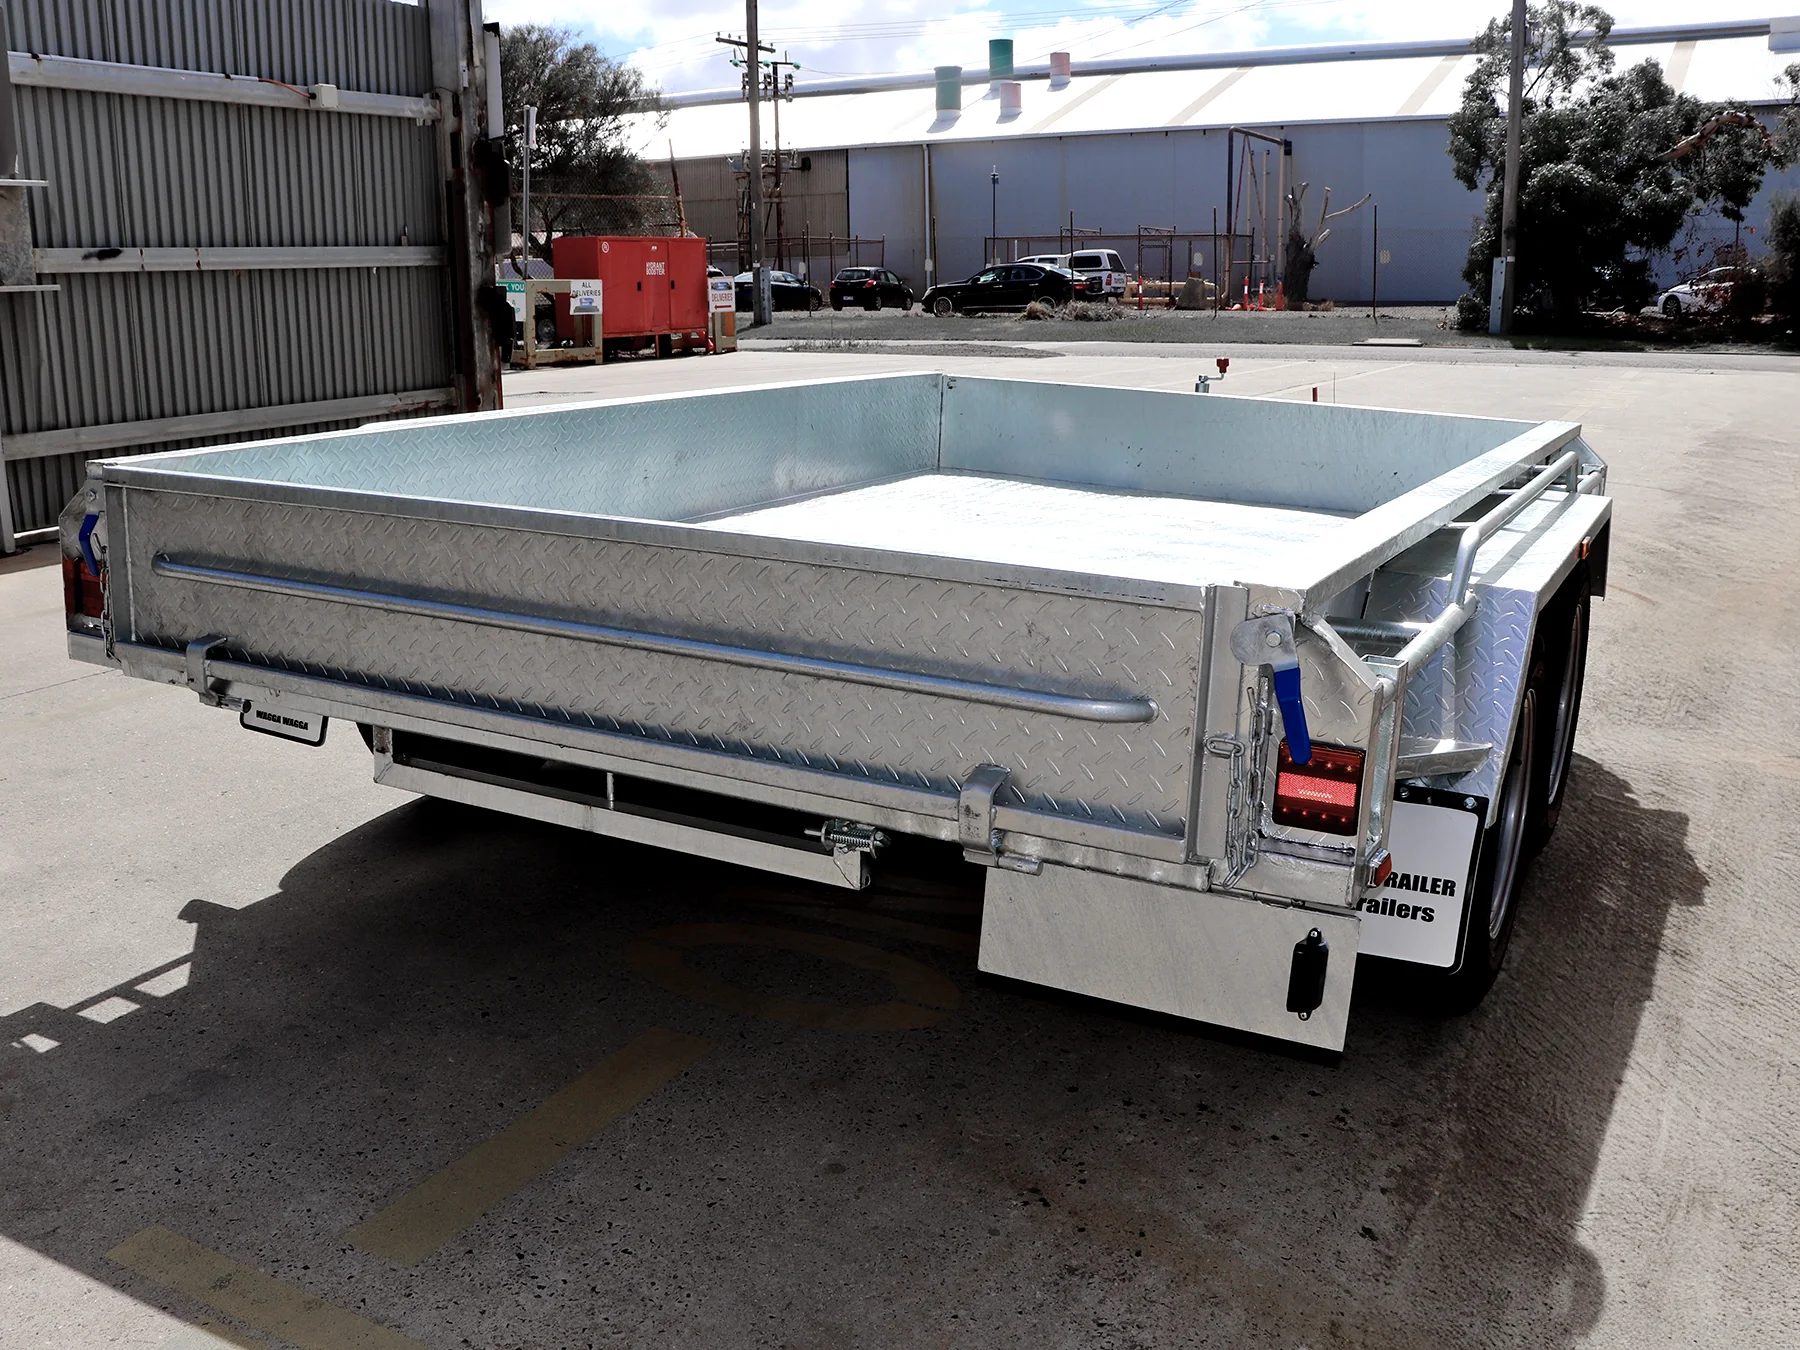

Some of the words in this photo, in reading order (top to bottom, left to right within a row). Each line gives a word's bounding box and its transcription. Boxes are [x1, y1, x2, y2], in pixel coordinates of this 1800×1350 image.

[646, 261, 665, 269] HYDRANT
[511, 283, 525, 291] YOU
[711, 293, 733, 302] DELIVERIES
[256, 710, 281, 724] WAGGA
[282, 716, 309, 730] WAGGA
[1351, 897, 1436, 923] railers
